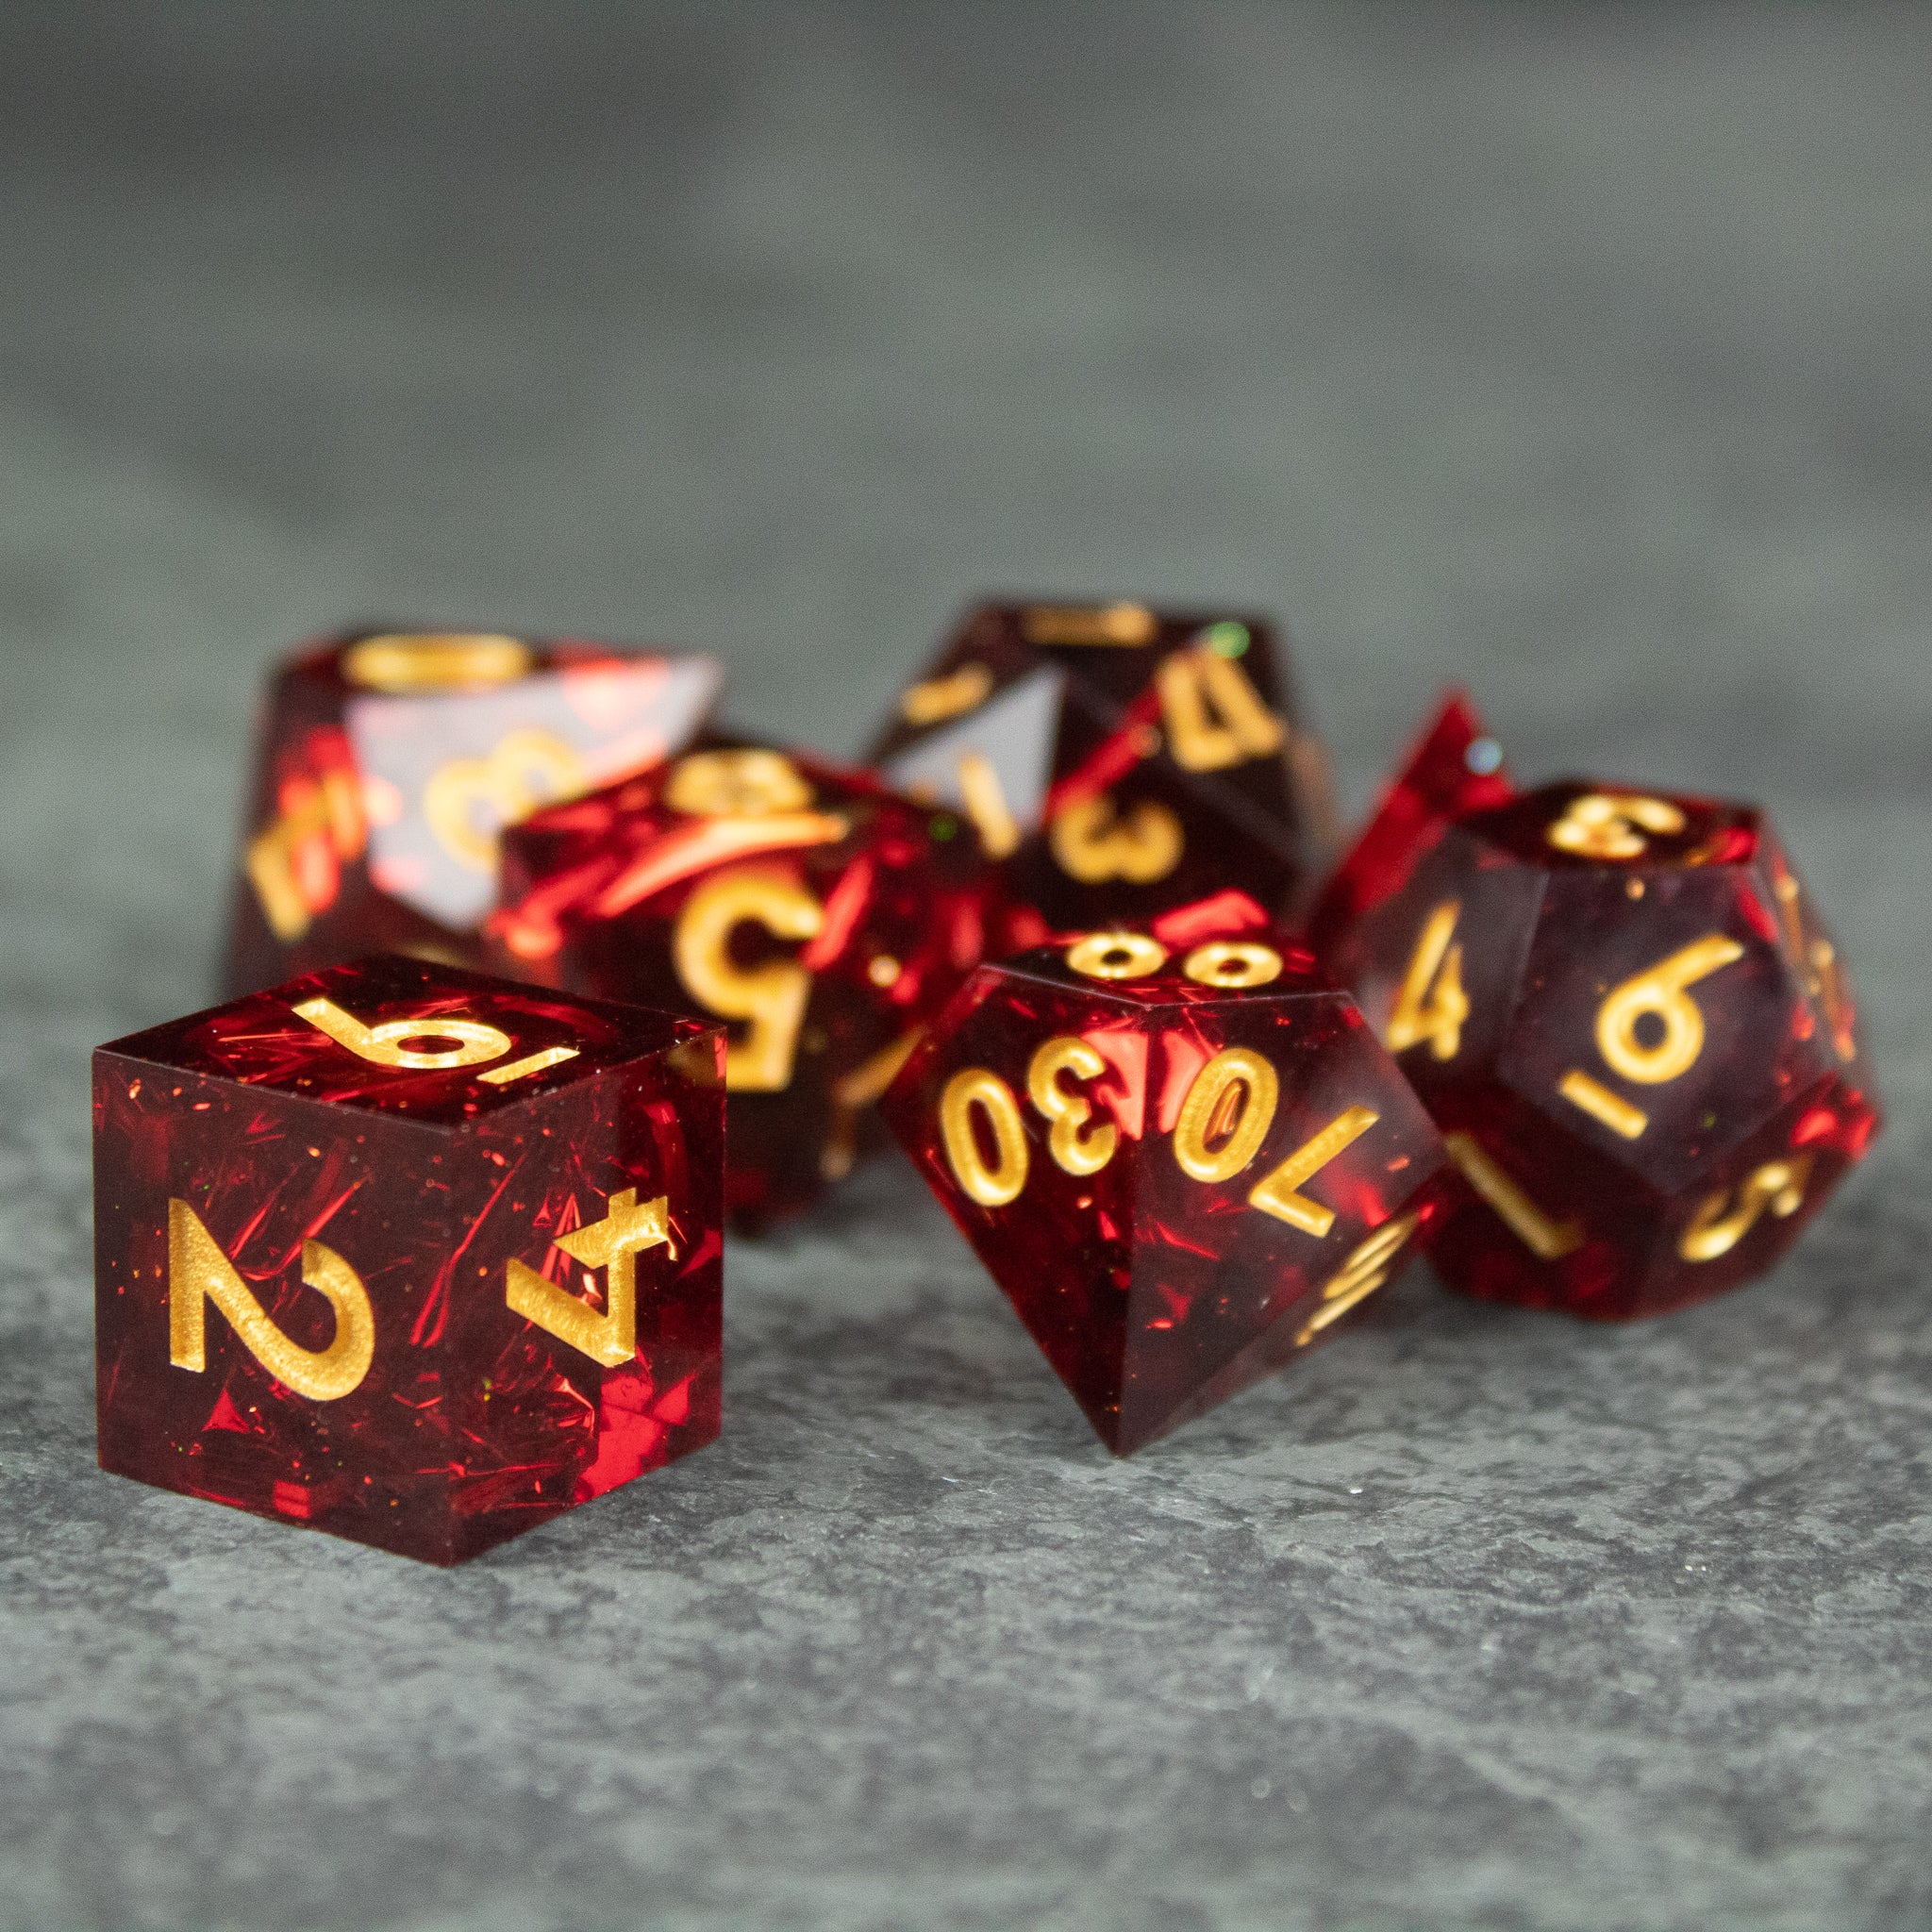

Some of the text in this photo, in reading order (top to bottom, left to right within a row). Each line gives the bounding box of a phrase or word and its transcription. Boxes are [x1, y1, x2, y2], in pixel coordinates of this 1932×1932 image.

[674, 870, 824, 1094] 5
[1387, 899, 1470, 1061] 4
[1596, 932, 1745, 1085] 6
[941, 1035, 1121, 1208] 30
[1173, 1046, 1381, 1239] 70
[168, 1196, 375, 1401] 2
[505, 1186, 669, 1368] 4
